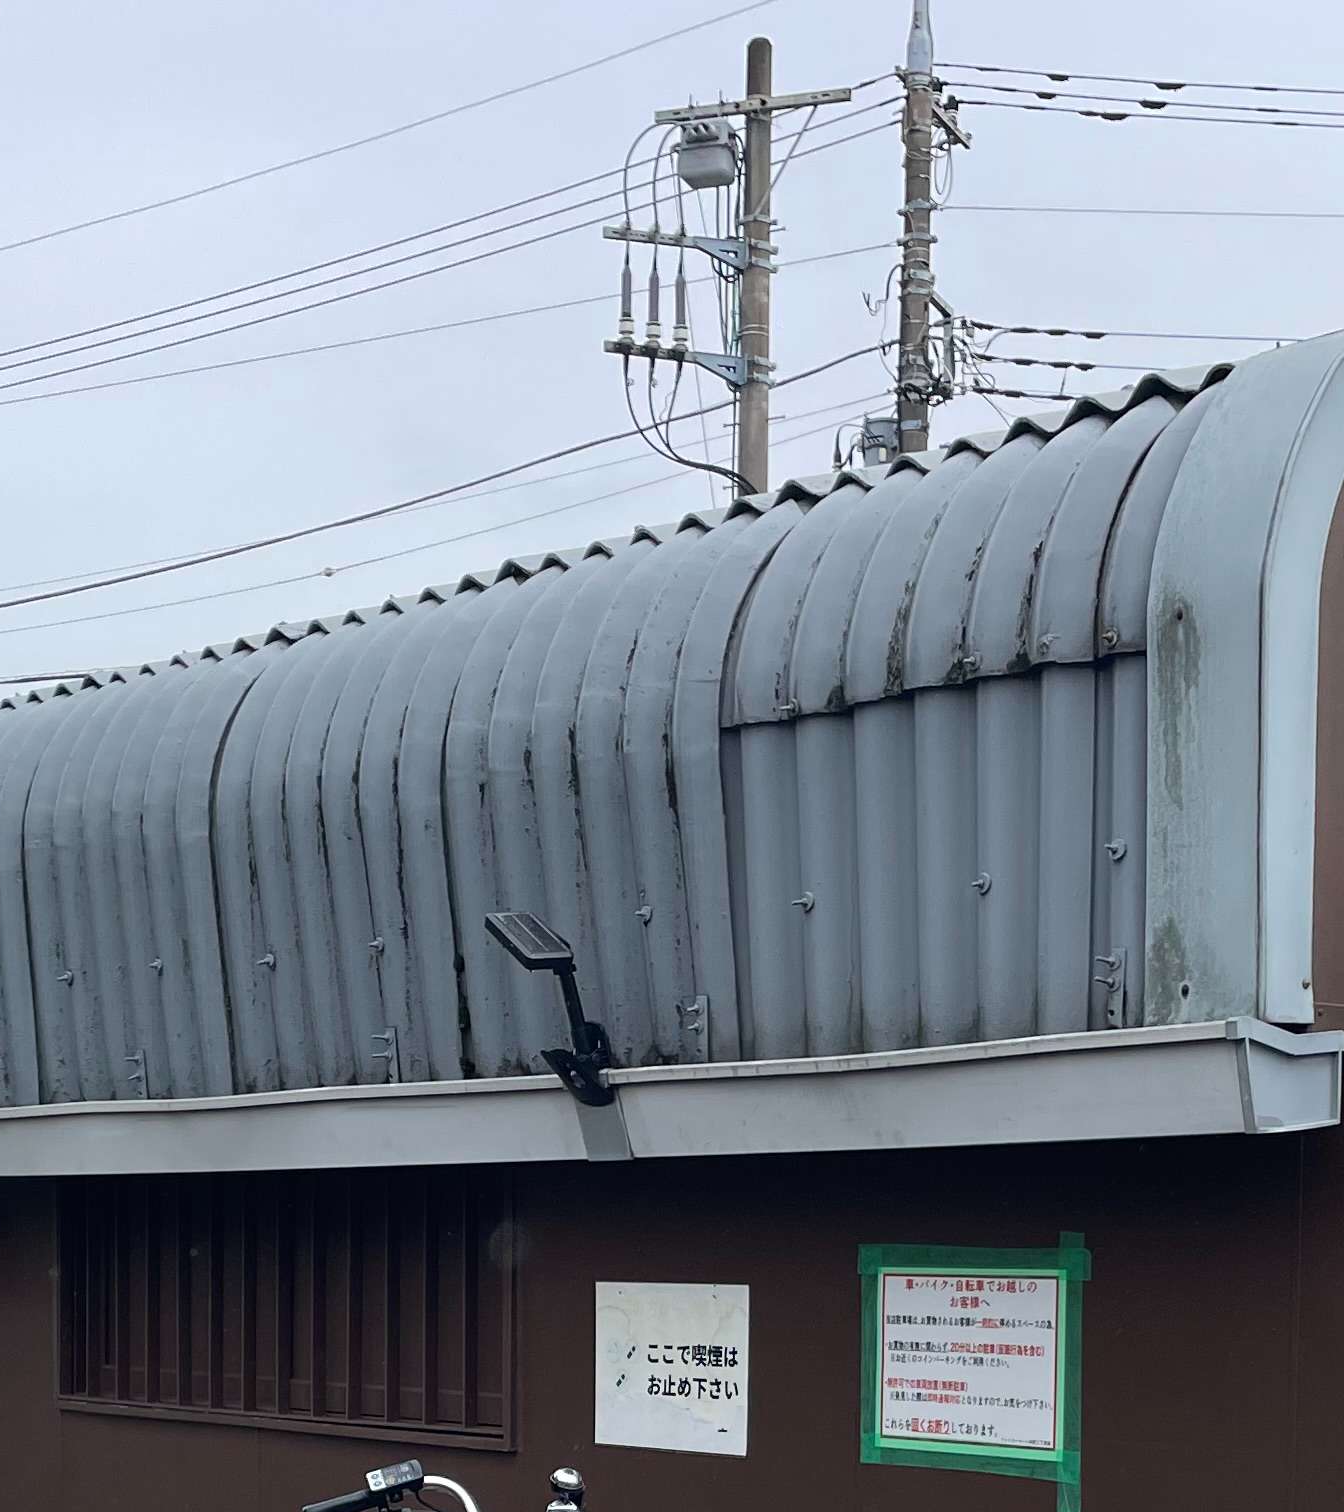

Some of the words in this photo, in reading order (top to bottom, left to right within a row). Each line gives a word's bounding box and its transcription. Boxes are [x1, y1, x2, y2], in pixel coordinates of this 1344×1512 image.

[949, 1296, 991, 1309] お客様へ
[647, 1344, 740, 1368] ここで喫煙は
[647, 1374, 740, 1401] お止め下さい
